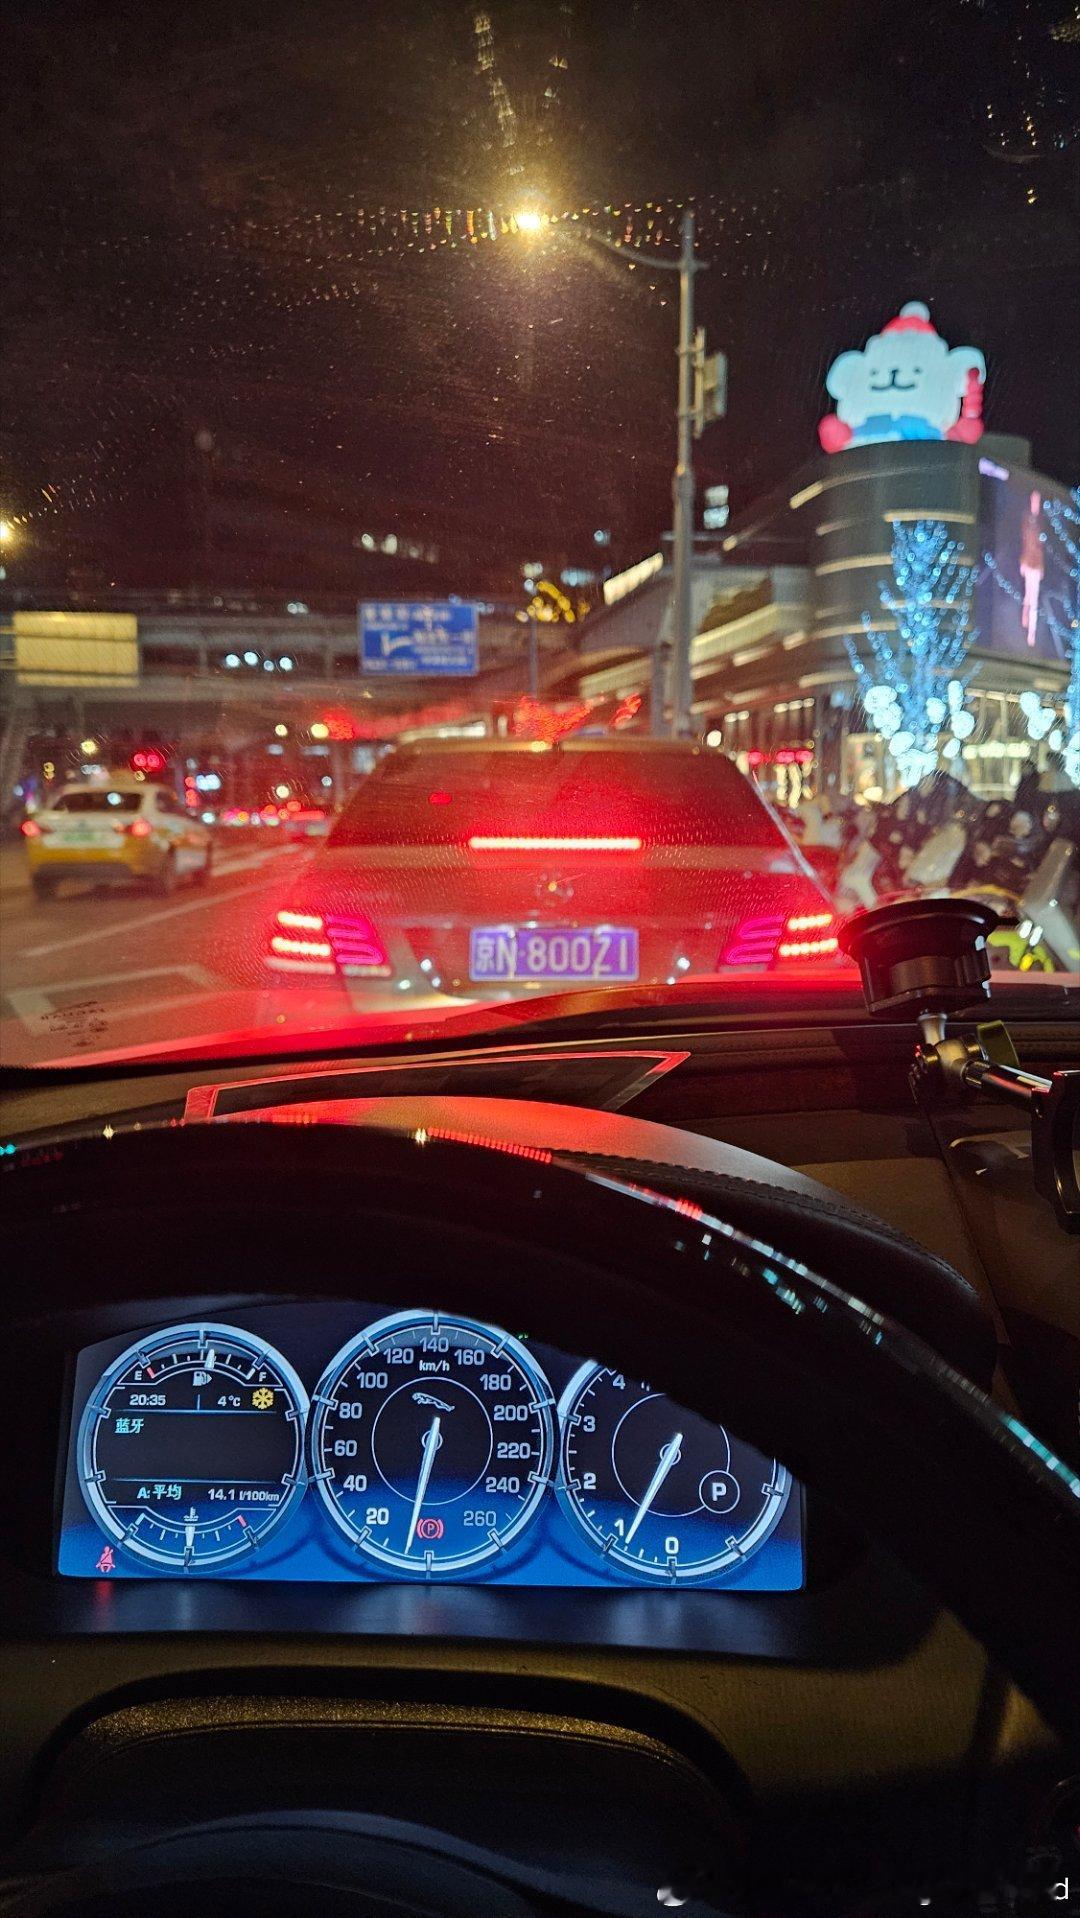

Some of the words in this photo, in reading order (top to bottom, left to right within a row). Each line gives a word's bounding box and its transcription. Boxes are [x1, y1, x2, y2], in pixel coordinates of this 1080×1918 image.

[420, 1337, 449, 1353] 140
[384, 1348, 414, 1365] 120
[454, 1349, 485, 1366] 160
[419, 1359, 450, 1372] km/h
[134, 1371, 142, 1381] E
[259, 1372, 267, 1382] F
[356, 1372, 388, 1389] 100
[480, 1374, 512, 1391] 180
[612, 1374, 626, 1390] 4
[129, 1394, 166, 1406] 20:35
[339, 1402, 363, 1419] 80
[494, 1404, 529, 1421] 200
[115, 1417, 145, 1434] 蓝牙
[583, 1415, 596, 1432] 3
[334, 1440, 358, 1457] 60
[497, 1442, 531, 1459] 220
[343, 1475, 367, 1492] 40
[485, 1476, 520, 1493] 240
[583, 1472, 597, 1490] 2
[208, 1488, 235, 1501] 14.1
[711, 1483, 728, 1501] P
[366, 1508, 389, 1525] 20
[463, 1510, 497, 1527] 260
[614, 1519, 625, 1536] 1
[665, 1537, 680, 1554] 0
